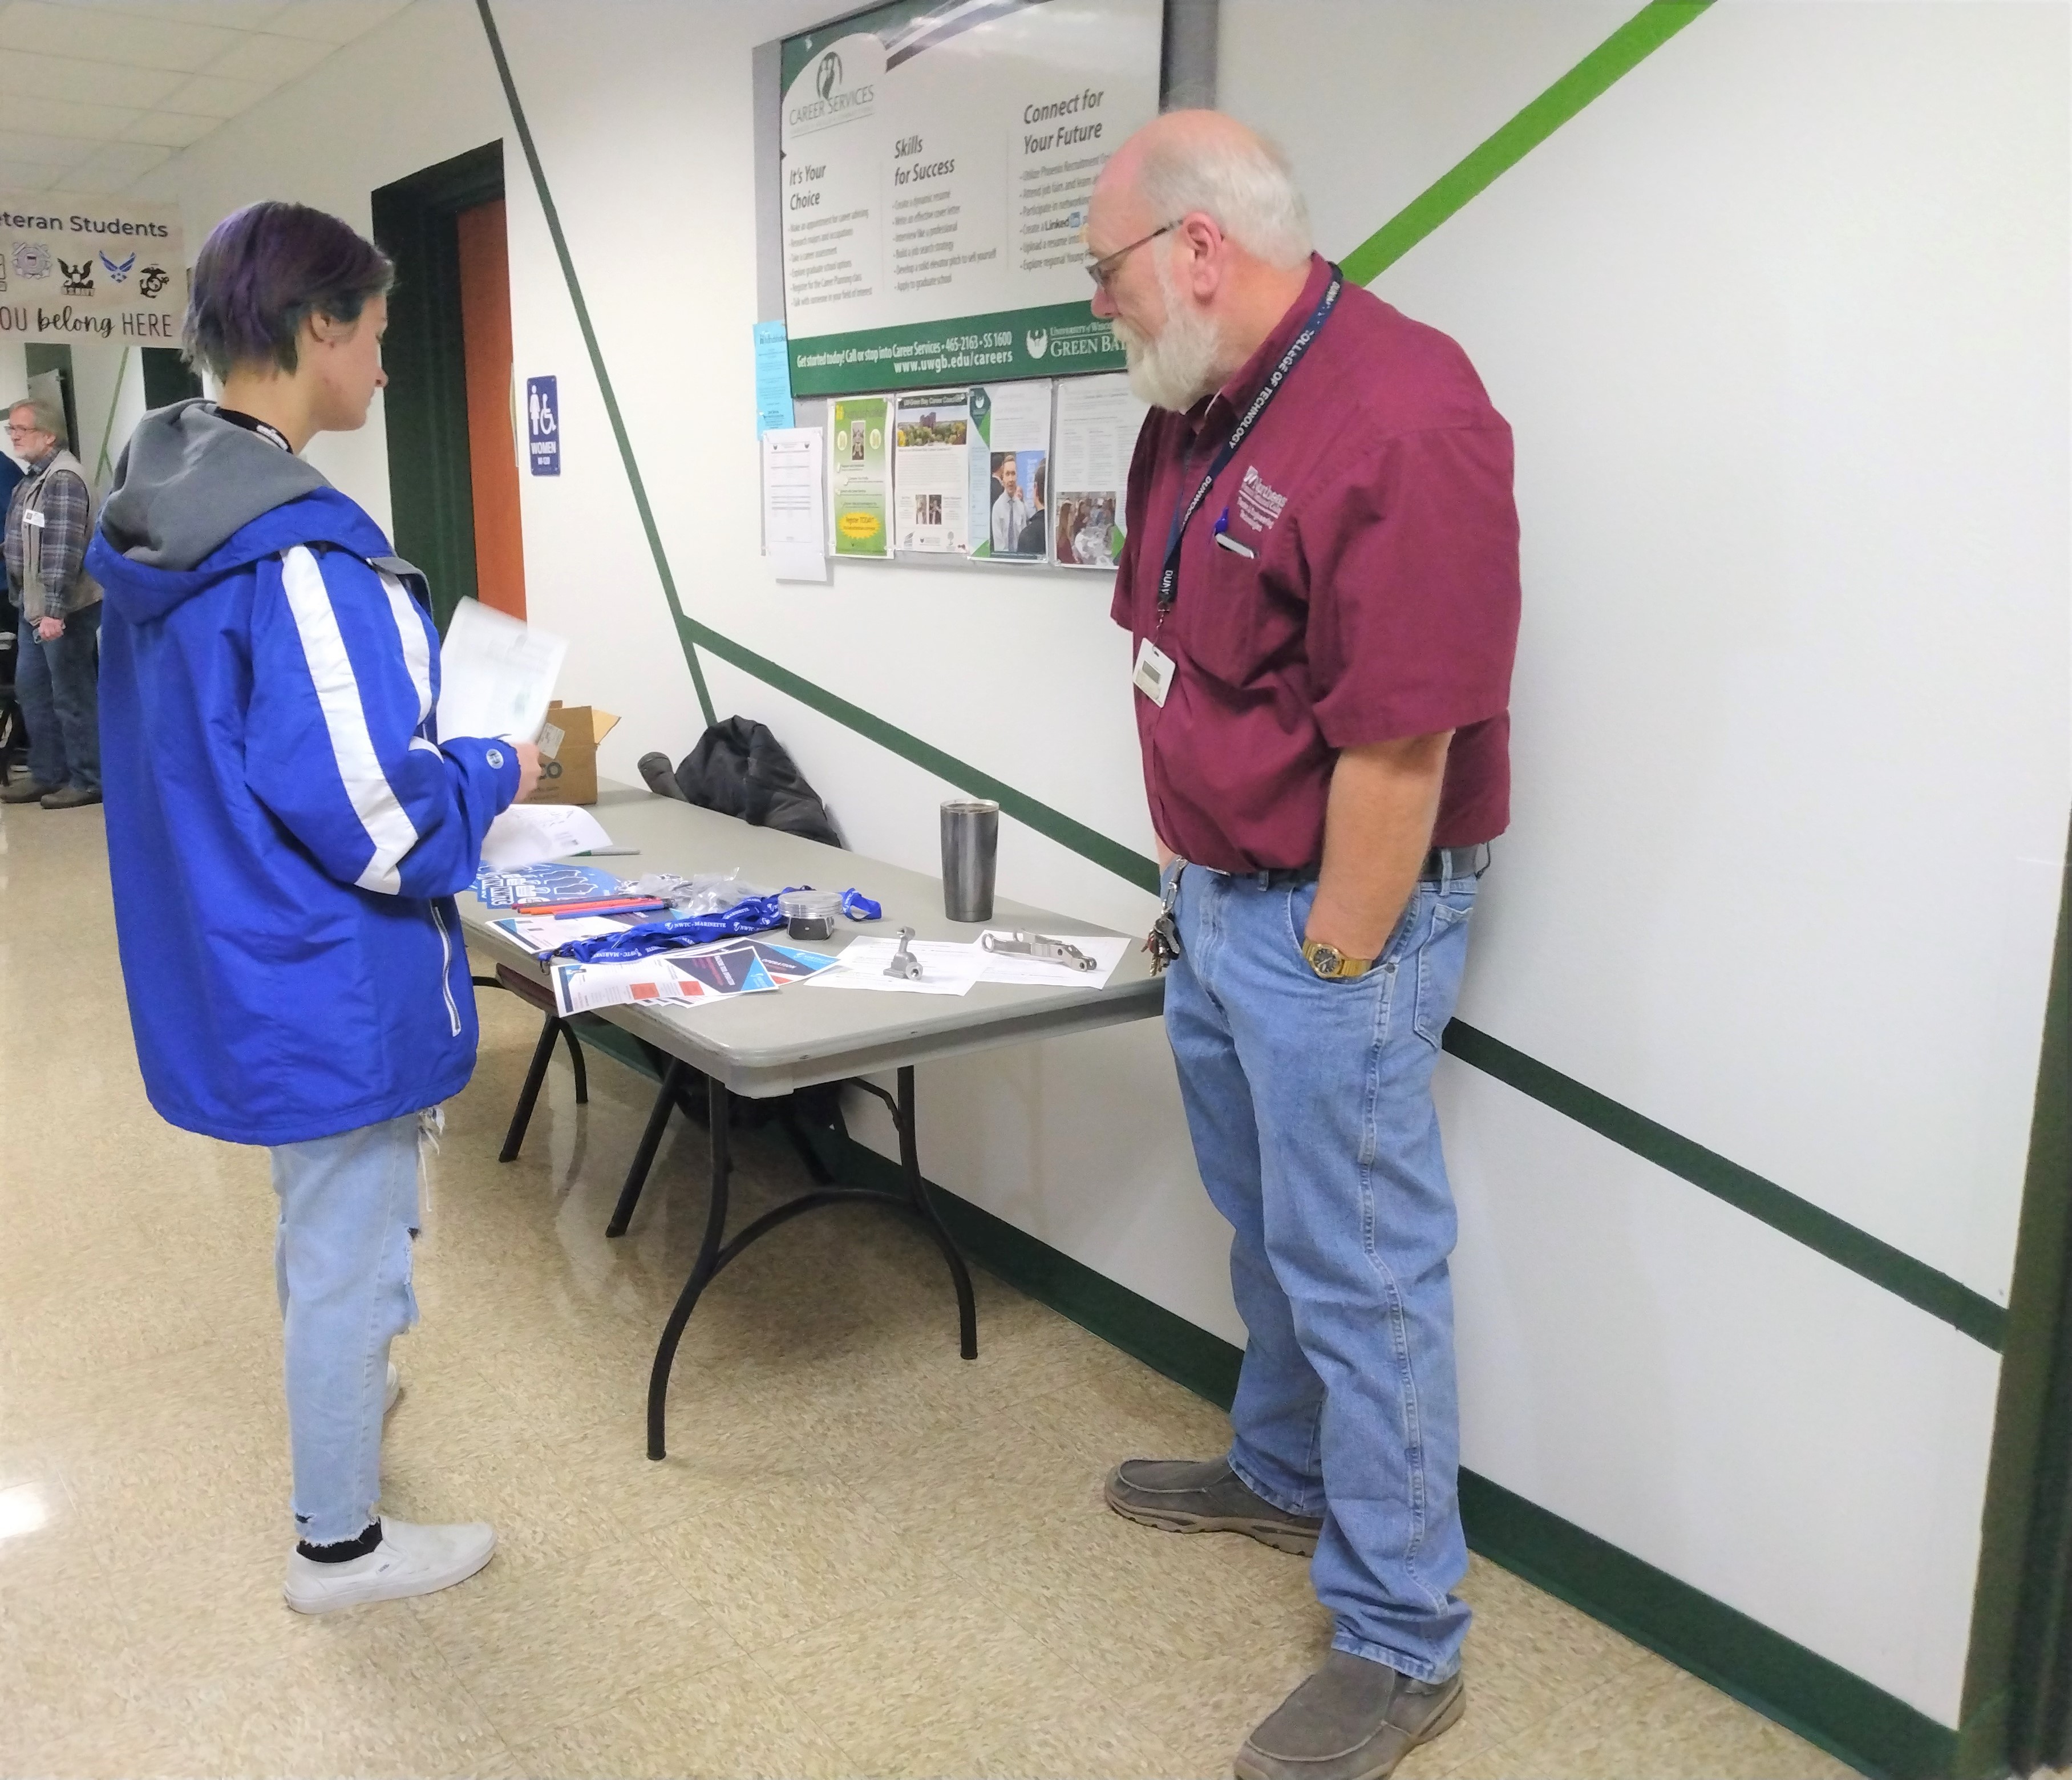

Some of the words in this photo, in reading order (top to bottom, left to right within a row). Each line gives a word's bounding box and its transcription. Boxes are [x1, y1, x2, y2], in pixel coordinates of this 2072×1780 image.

[790, 100, 824, 126] CAREER
[827, 84, 874, 114] SERVICES
[1023, 94, 1080, 125] Connect
[1082, 88, 1104, 111] for
[895, 135, 923, 159] Skills
[1024, 133, 1054, 155] Your
[1056, 122, 1103, 148] Future
[790, 167, 803, 186] It's
[805, 164, 826, 183] Your
[895, 167, 911, 187] for
[912, 159, 955, 182] Success
[790, 190, 820, 211] Choice
[70, 215, 169, 237] Students
[37, 305, 115, 338] belong
[122, 313, 173, 337] HERE
[797, 355, 806, 367] Get
[807, 351, 827, 366] started
[827, 349, 845, 367] today!
[845, 349, 857, 362] Call
[857, 351, 864, 362] or
[865, 349, 878, 363] stop
[879, 346, 892, 359] into
[893, 343, 913, 358] Career
[914, 341, 941, 355] Services
[945, 334, 978, 352] 465-2163
[984, 333, 993, 348] SS
[993, 331, 1012, 347] 1600
[1050, 338, 1098, 357] GREEN
[893, 350, 1013, 373] www.uwgb.edu/careers
[1270, 371, 1283, 387] OF
[1229, 387, 1273, 450] TECHNOLOGY
[531, 441, 557, 455] WOMEN
[762, 958, 797, 969] OPERATION
